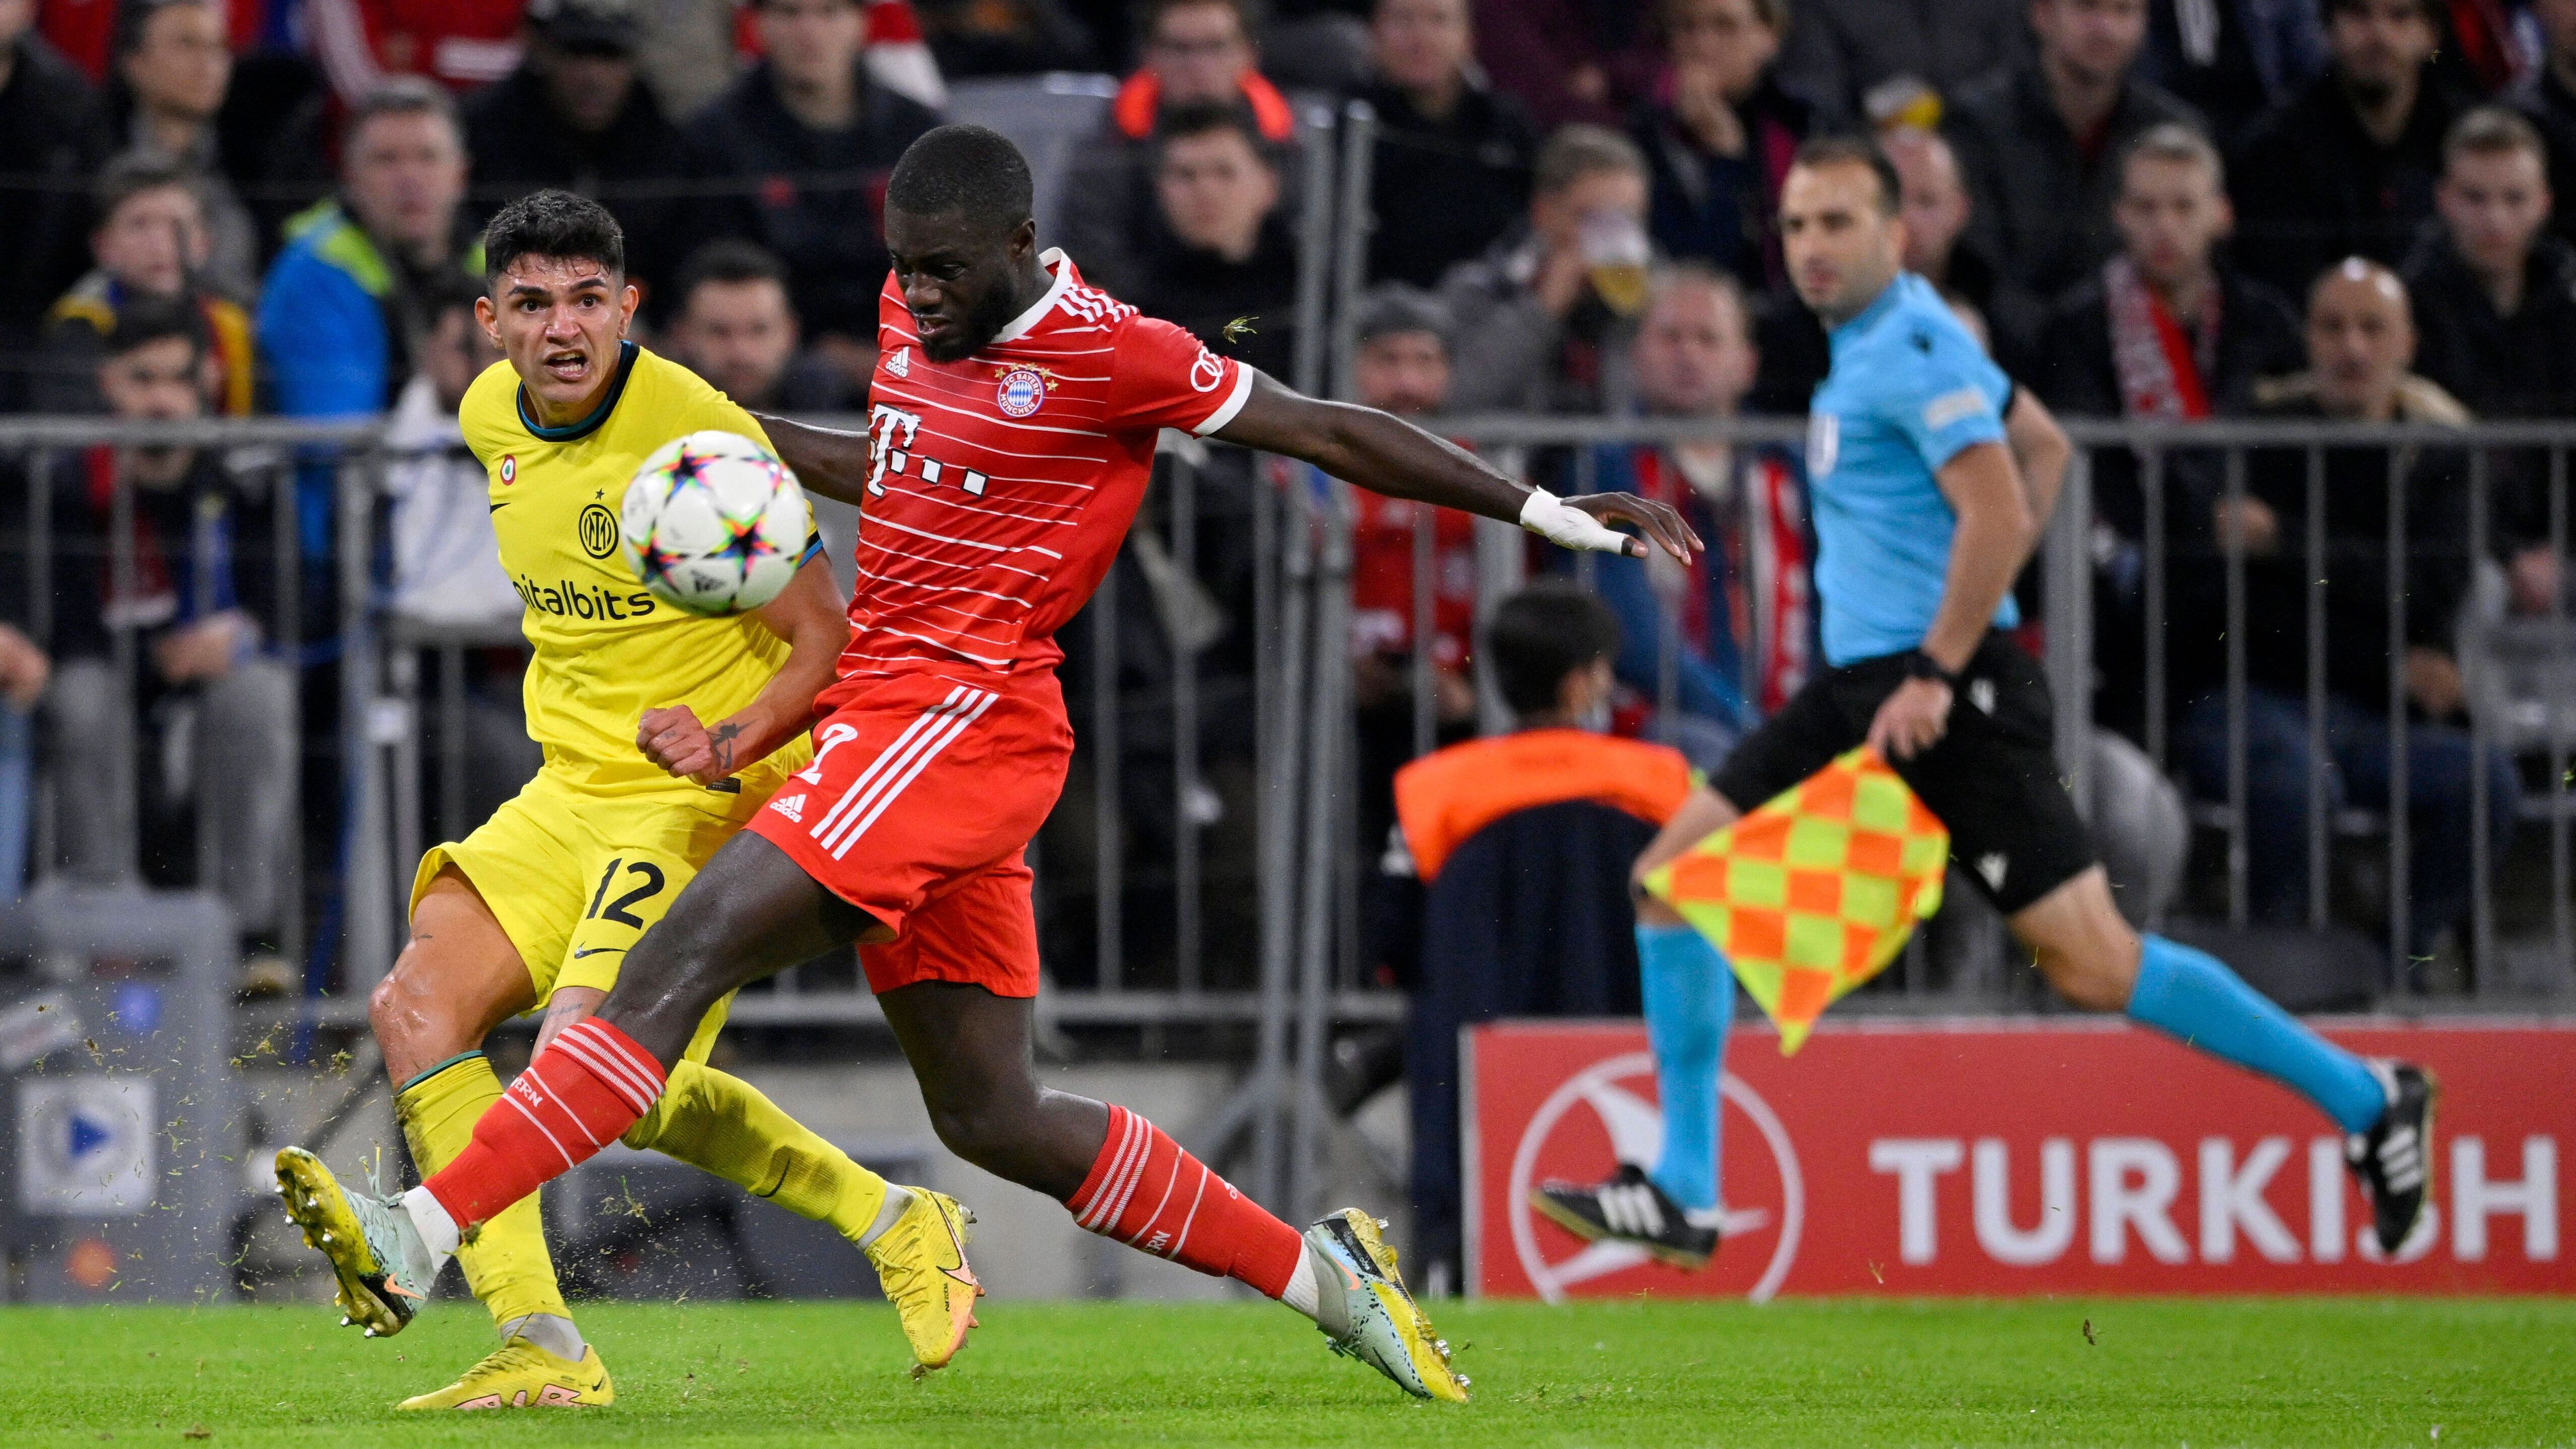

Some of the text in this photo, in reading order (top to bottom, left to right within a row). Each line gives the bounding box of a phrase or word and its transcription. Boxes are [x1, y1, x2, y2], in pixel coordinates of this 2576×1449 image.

[885, 361, 908, 378] adidas
[1005, 374, 1040, 395] FC BAYERN
[769, 802, 802, 823] adidas
[586, 858, 665, 930] 12
